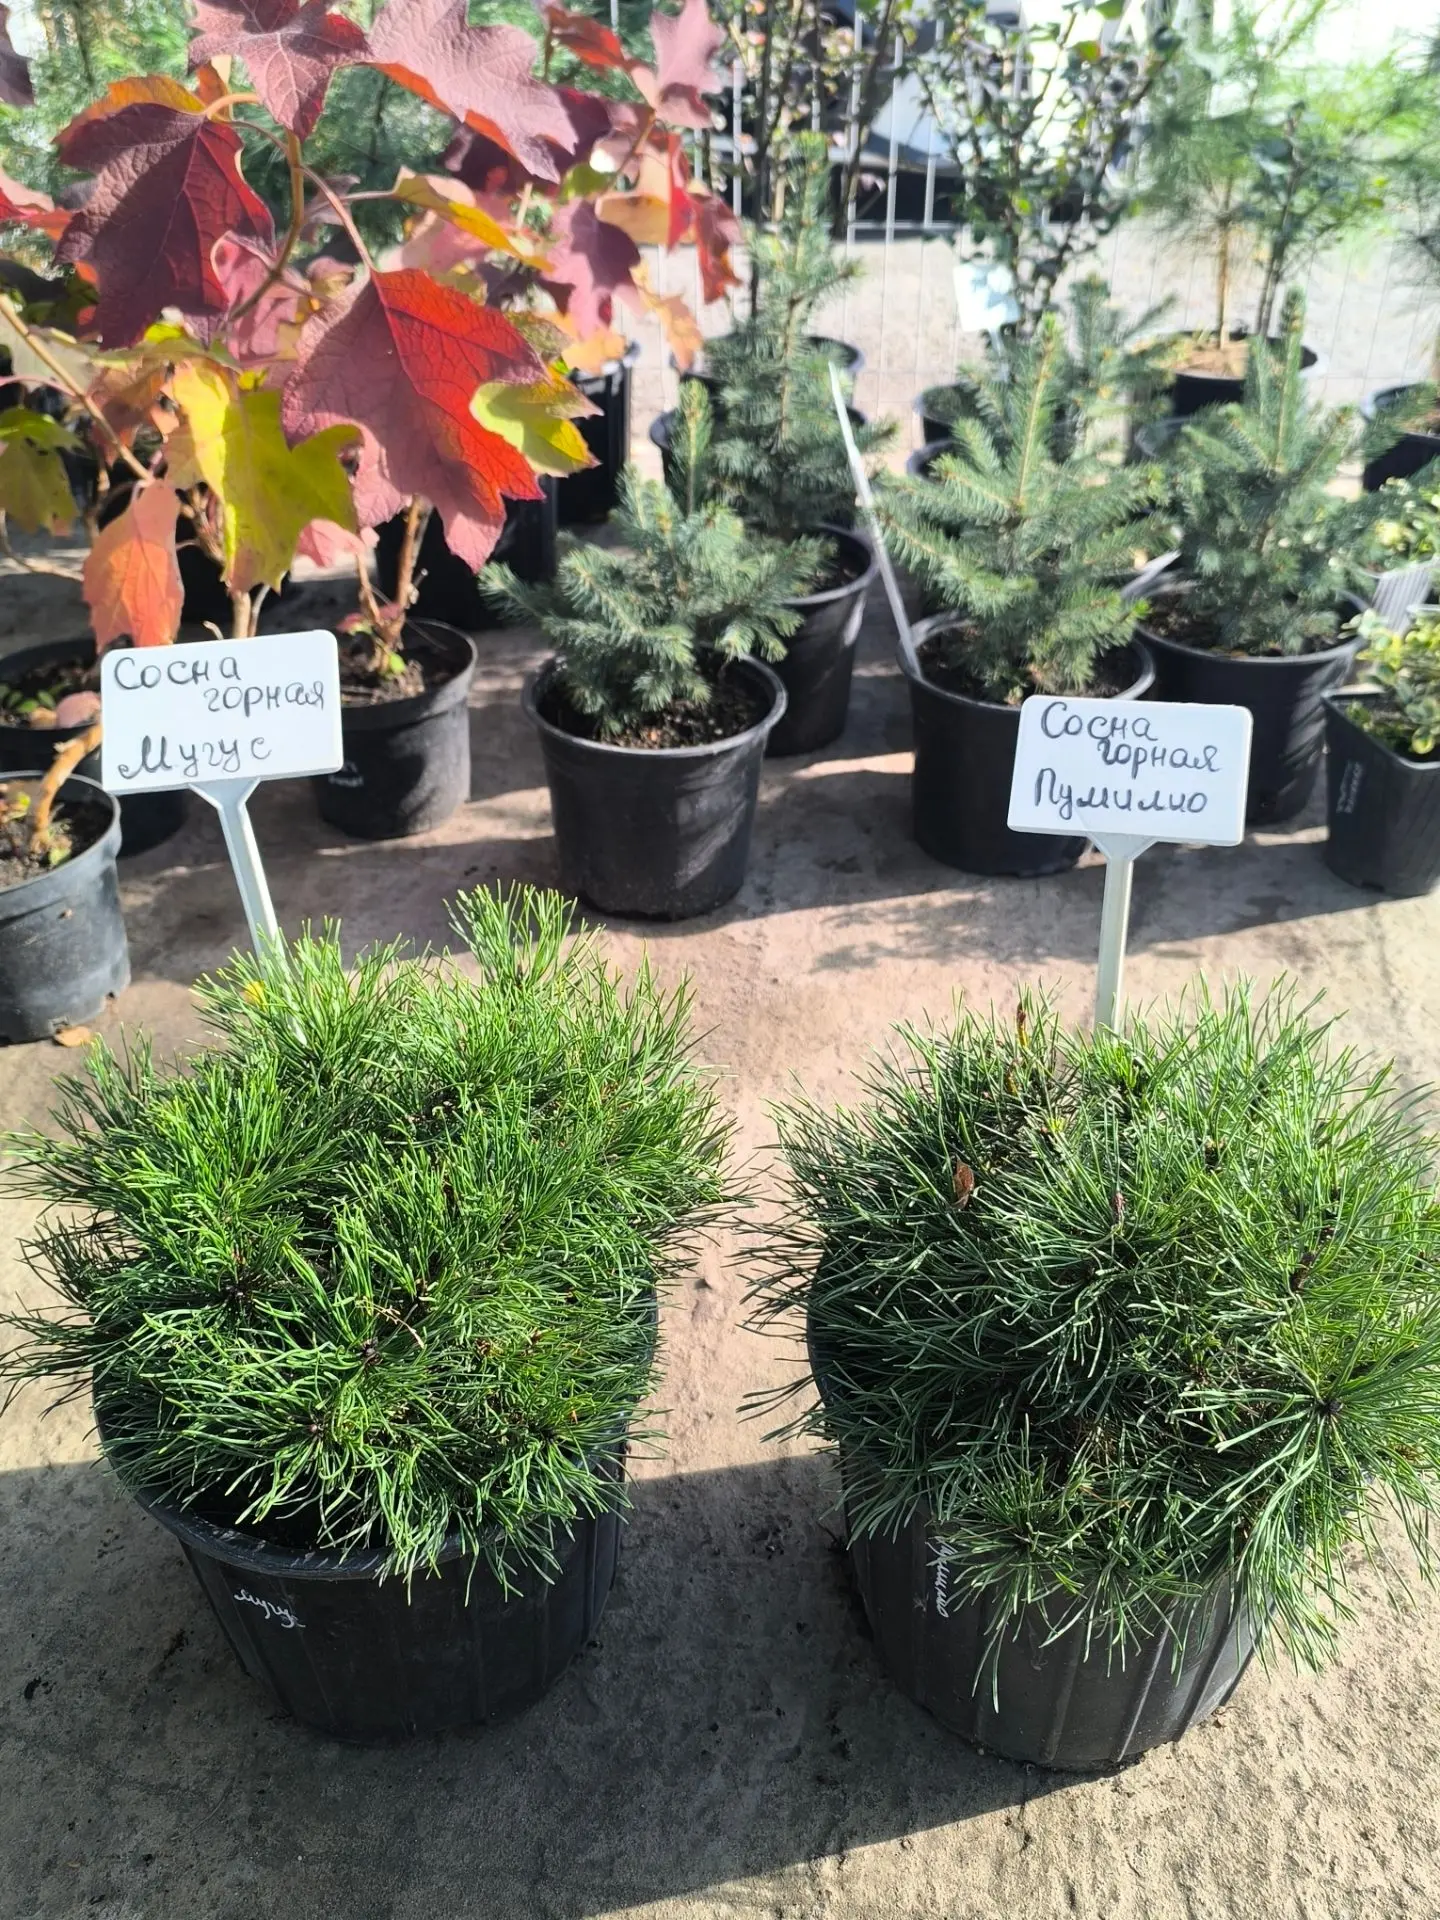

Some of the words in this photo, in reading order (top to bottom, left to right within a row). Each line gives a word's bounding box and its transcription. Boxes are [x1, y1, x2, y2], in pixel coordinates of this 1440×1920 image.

[114, 656, 242, 690] Сосна
[203, 680, 325, 718] горная
[1040, 701, 1159, 742] Сосна
[117, 735, 273, 780] Мугус
[1097, 738, 1222, 780] горная
[1033, 767, 1209, 821] Пумилио
